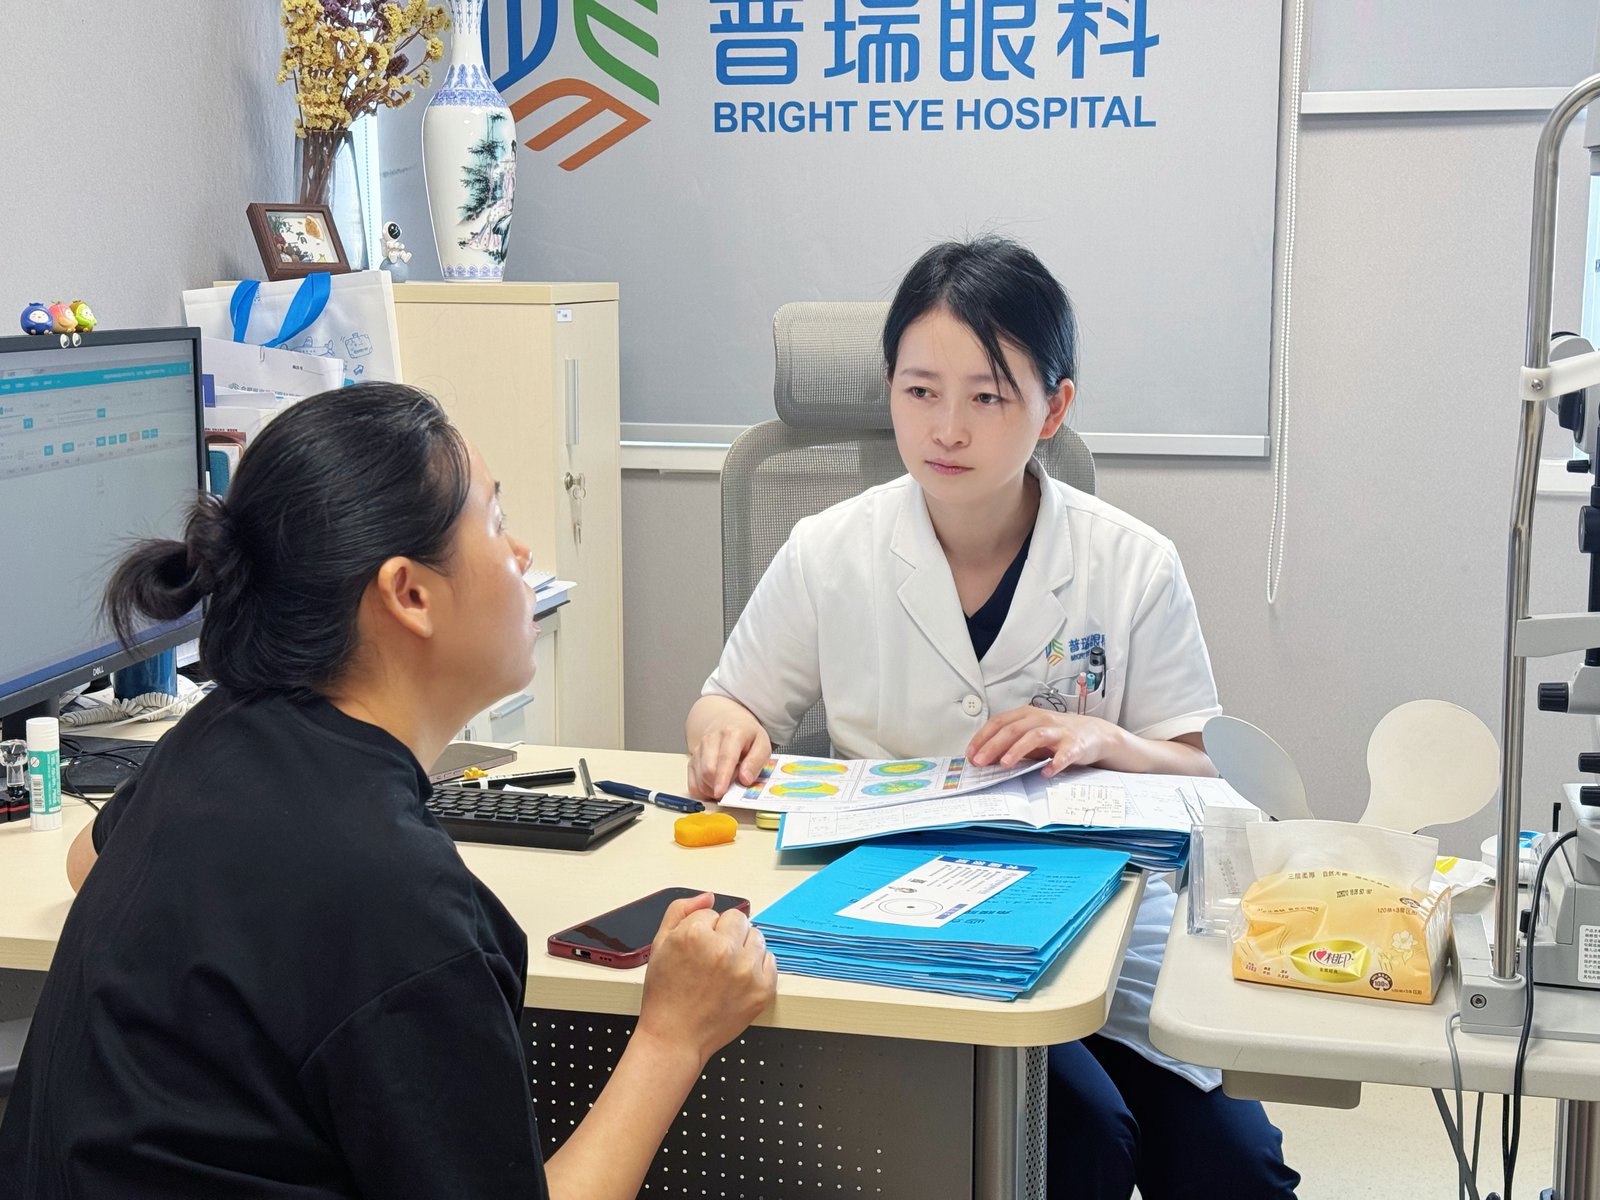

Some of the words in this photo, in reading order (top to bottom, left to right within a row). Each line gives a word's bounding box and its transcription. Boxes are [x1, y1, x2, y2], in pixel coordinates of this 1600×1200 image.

[709, 0, 1160, 86] 普瑞眼科
[713, 100, 858, 133] BRIGHT
[868, 99, 944, 132] EYE
[956, 95, 1157, 130] HOSPITAL
